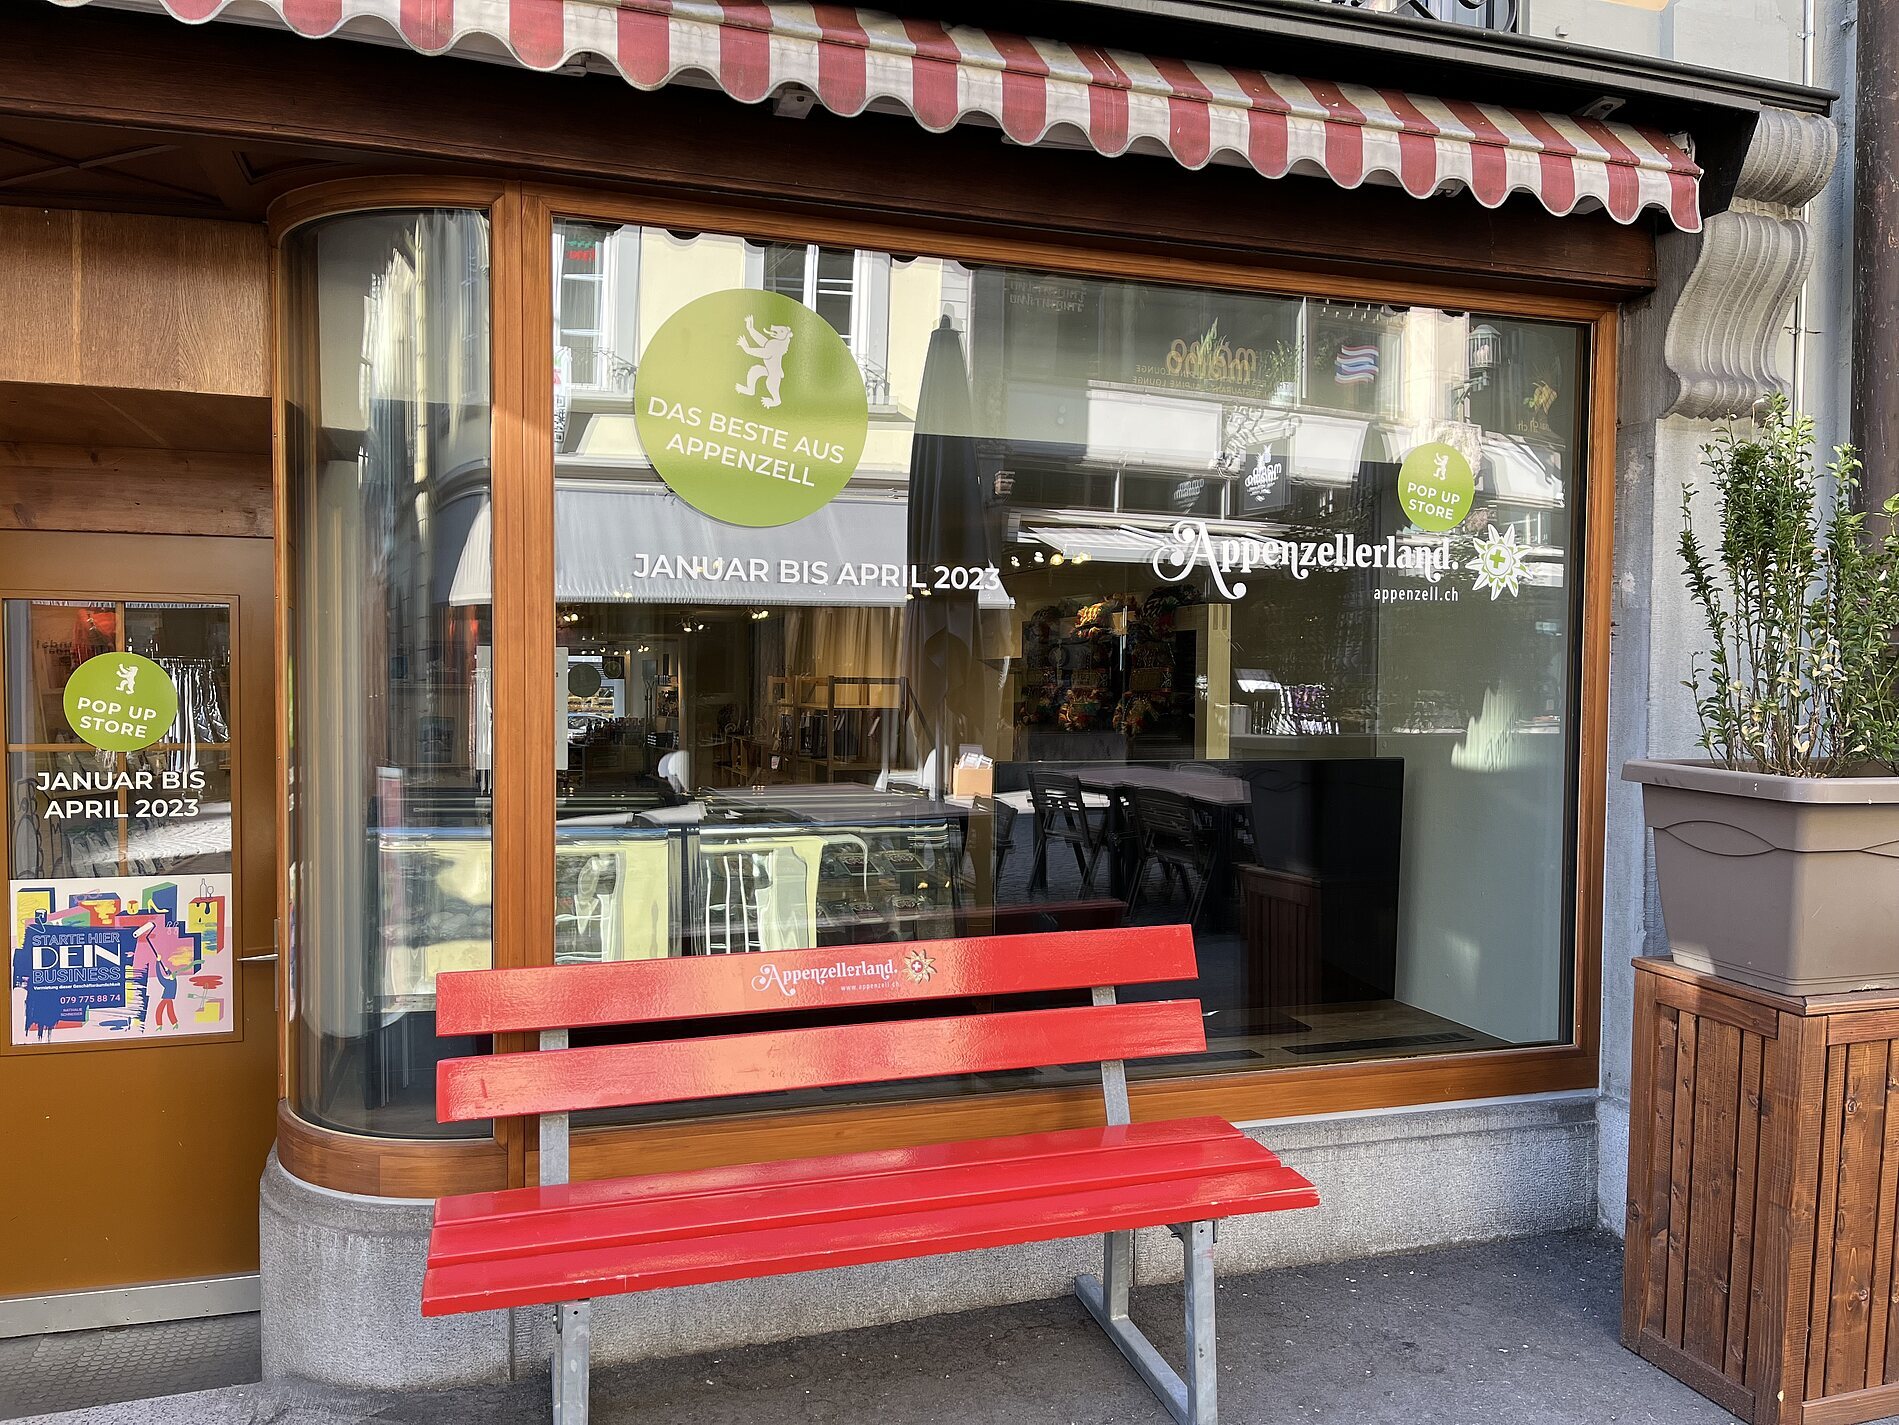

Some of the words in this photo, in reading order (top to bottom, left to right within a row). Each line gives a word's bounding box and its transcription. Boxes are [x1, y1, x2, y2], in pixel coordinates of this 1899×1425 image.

[647, 396, 702, 427] DAS
[709, 412, 789, 451] BESTE
[793, 436, 845, 465] AUS
[666, 433, 815, 487] APPENZELL
[1407, 482, 1437, 499] POP
[1441, 491, 1460, 505] UP
[1408, 499, 1454, 520] STORE
[633, 553, 770, 583] JANUAR
[779, 560, 829, 586] BIS
[837, 562, 927, 589] APRIL
[932, 565, 1001, 591] 2023
[1373, 587, 1459, 602] appenzell.ch
[77, 696, 122, 715] POP
[128, 705, 157, 721] UP
[79, 716, 148, 739] STORE
[36, 771, 153, 791] JANUAR
[162, 771, 206, 790] BIS
[43, 800, 129, 819] APRIL
[135, 799, 199, 818] 2023
[32, 933, 85, 946] STARTE
[88, 932, 120, 943] HIER
[32, 943, 121, 970] DEIN
[32, 967, 121, 984] BUSINESS
[60, 996, 76, 1004] 079
[79, 995, 95, 1003] 775
[110, 994, 121, 1002] 74
